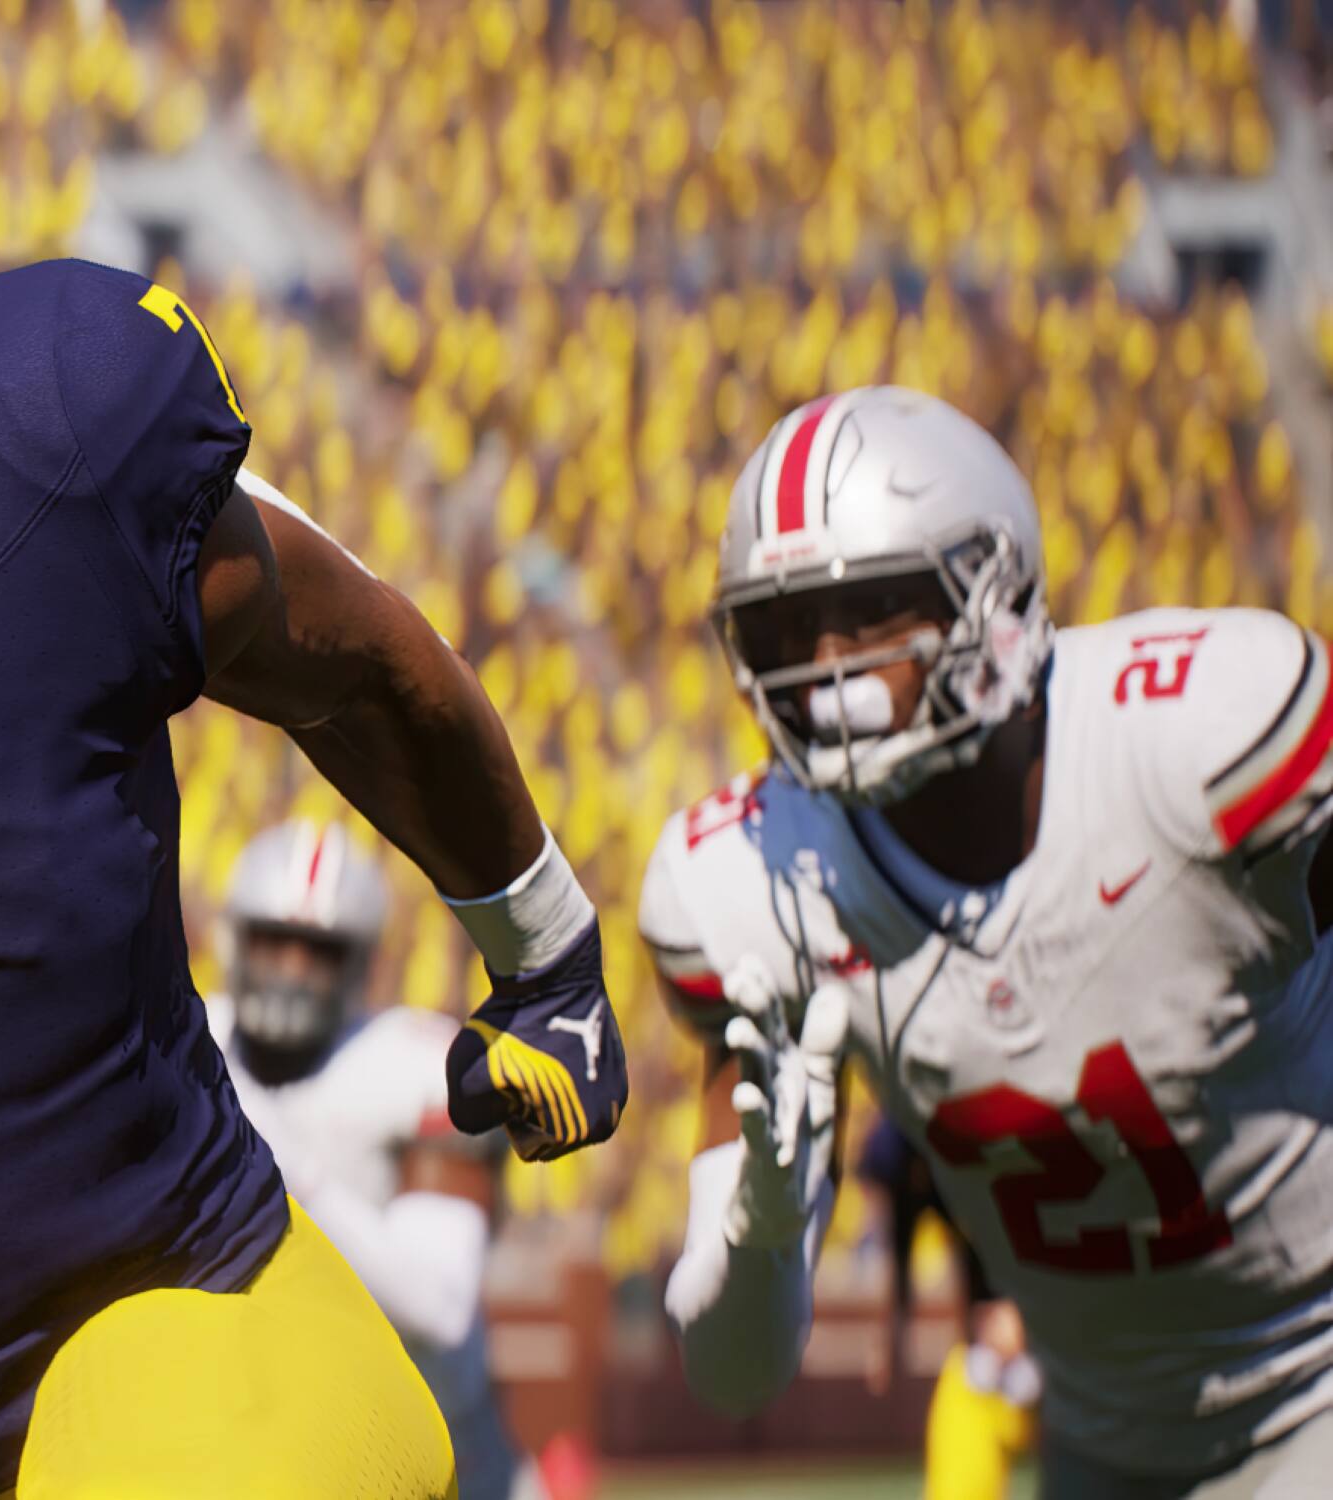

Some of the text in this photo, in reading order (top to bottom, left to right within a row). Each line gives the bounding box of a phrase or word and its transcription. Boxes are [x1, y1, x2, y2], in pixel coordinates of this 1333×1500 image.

[137, 283, 246, 423] 7
[1114, 626, 1208, 705] 21
[926, 1038, 1233, 1276] 21
